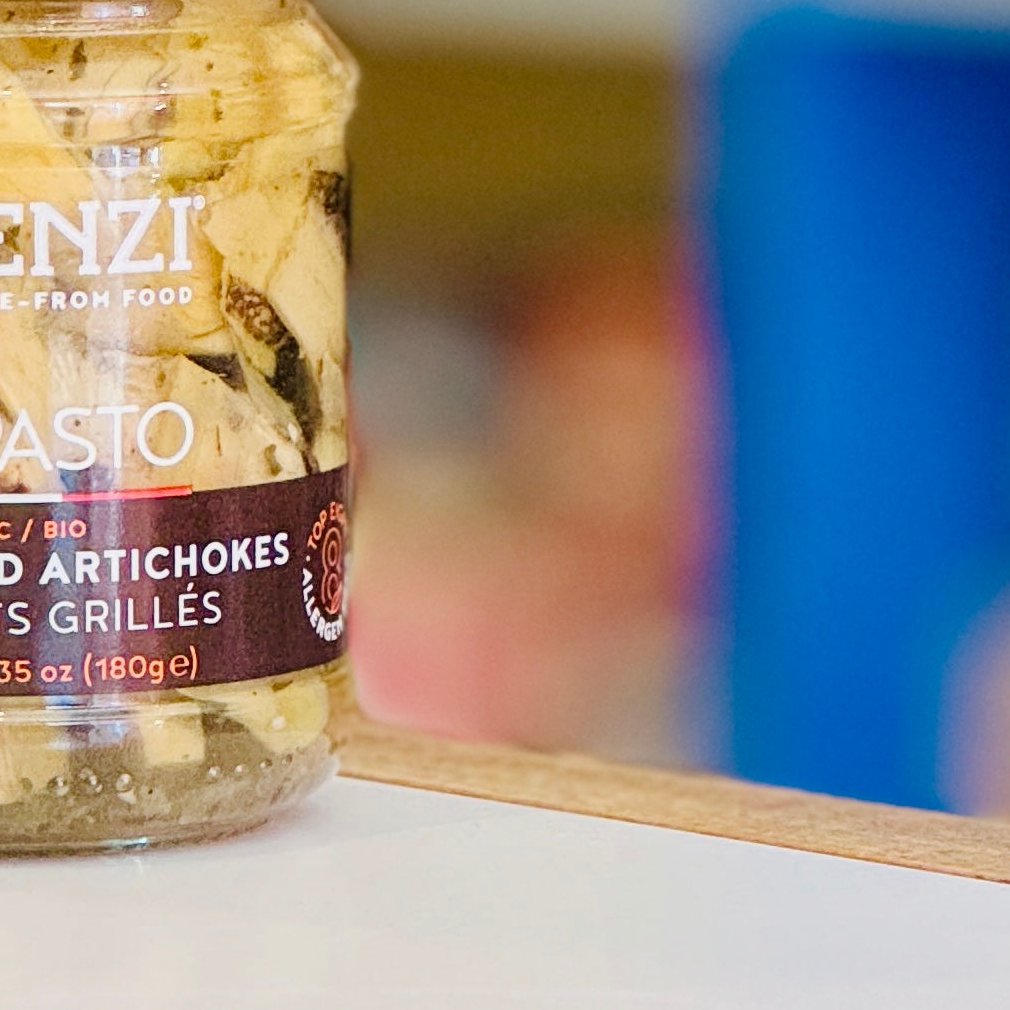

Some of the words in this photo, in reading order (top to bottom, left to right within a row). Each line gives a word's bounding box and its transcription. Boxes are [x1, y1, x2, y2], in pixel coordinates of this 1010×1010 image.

[122, 285, 194, 308] FOOD
[21, 518, 33, 543] /
[43, 519, 87, 539] BIO
[306, 509, 327, 550] TOP
[38, 531, 290, 586] ARTICHOKES
[48, 582, 222, 634] GRILLÉS
[40, 664, 73, 682] oz
